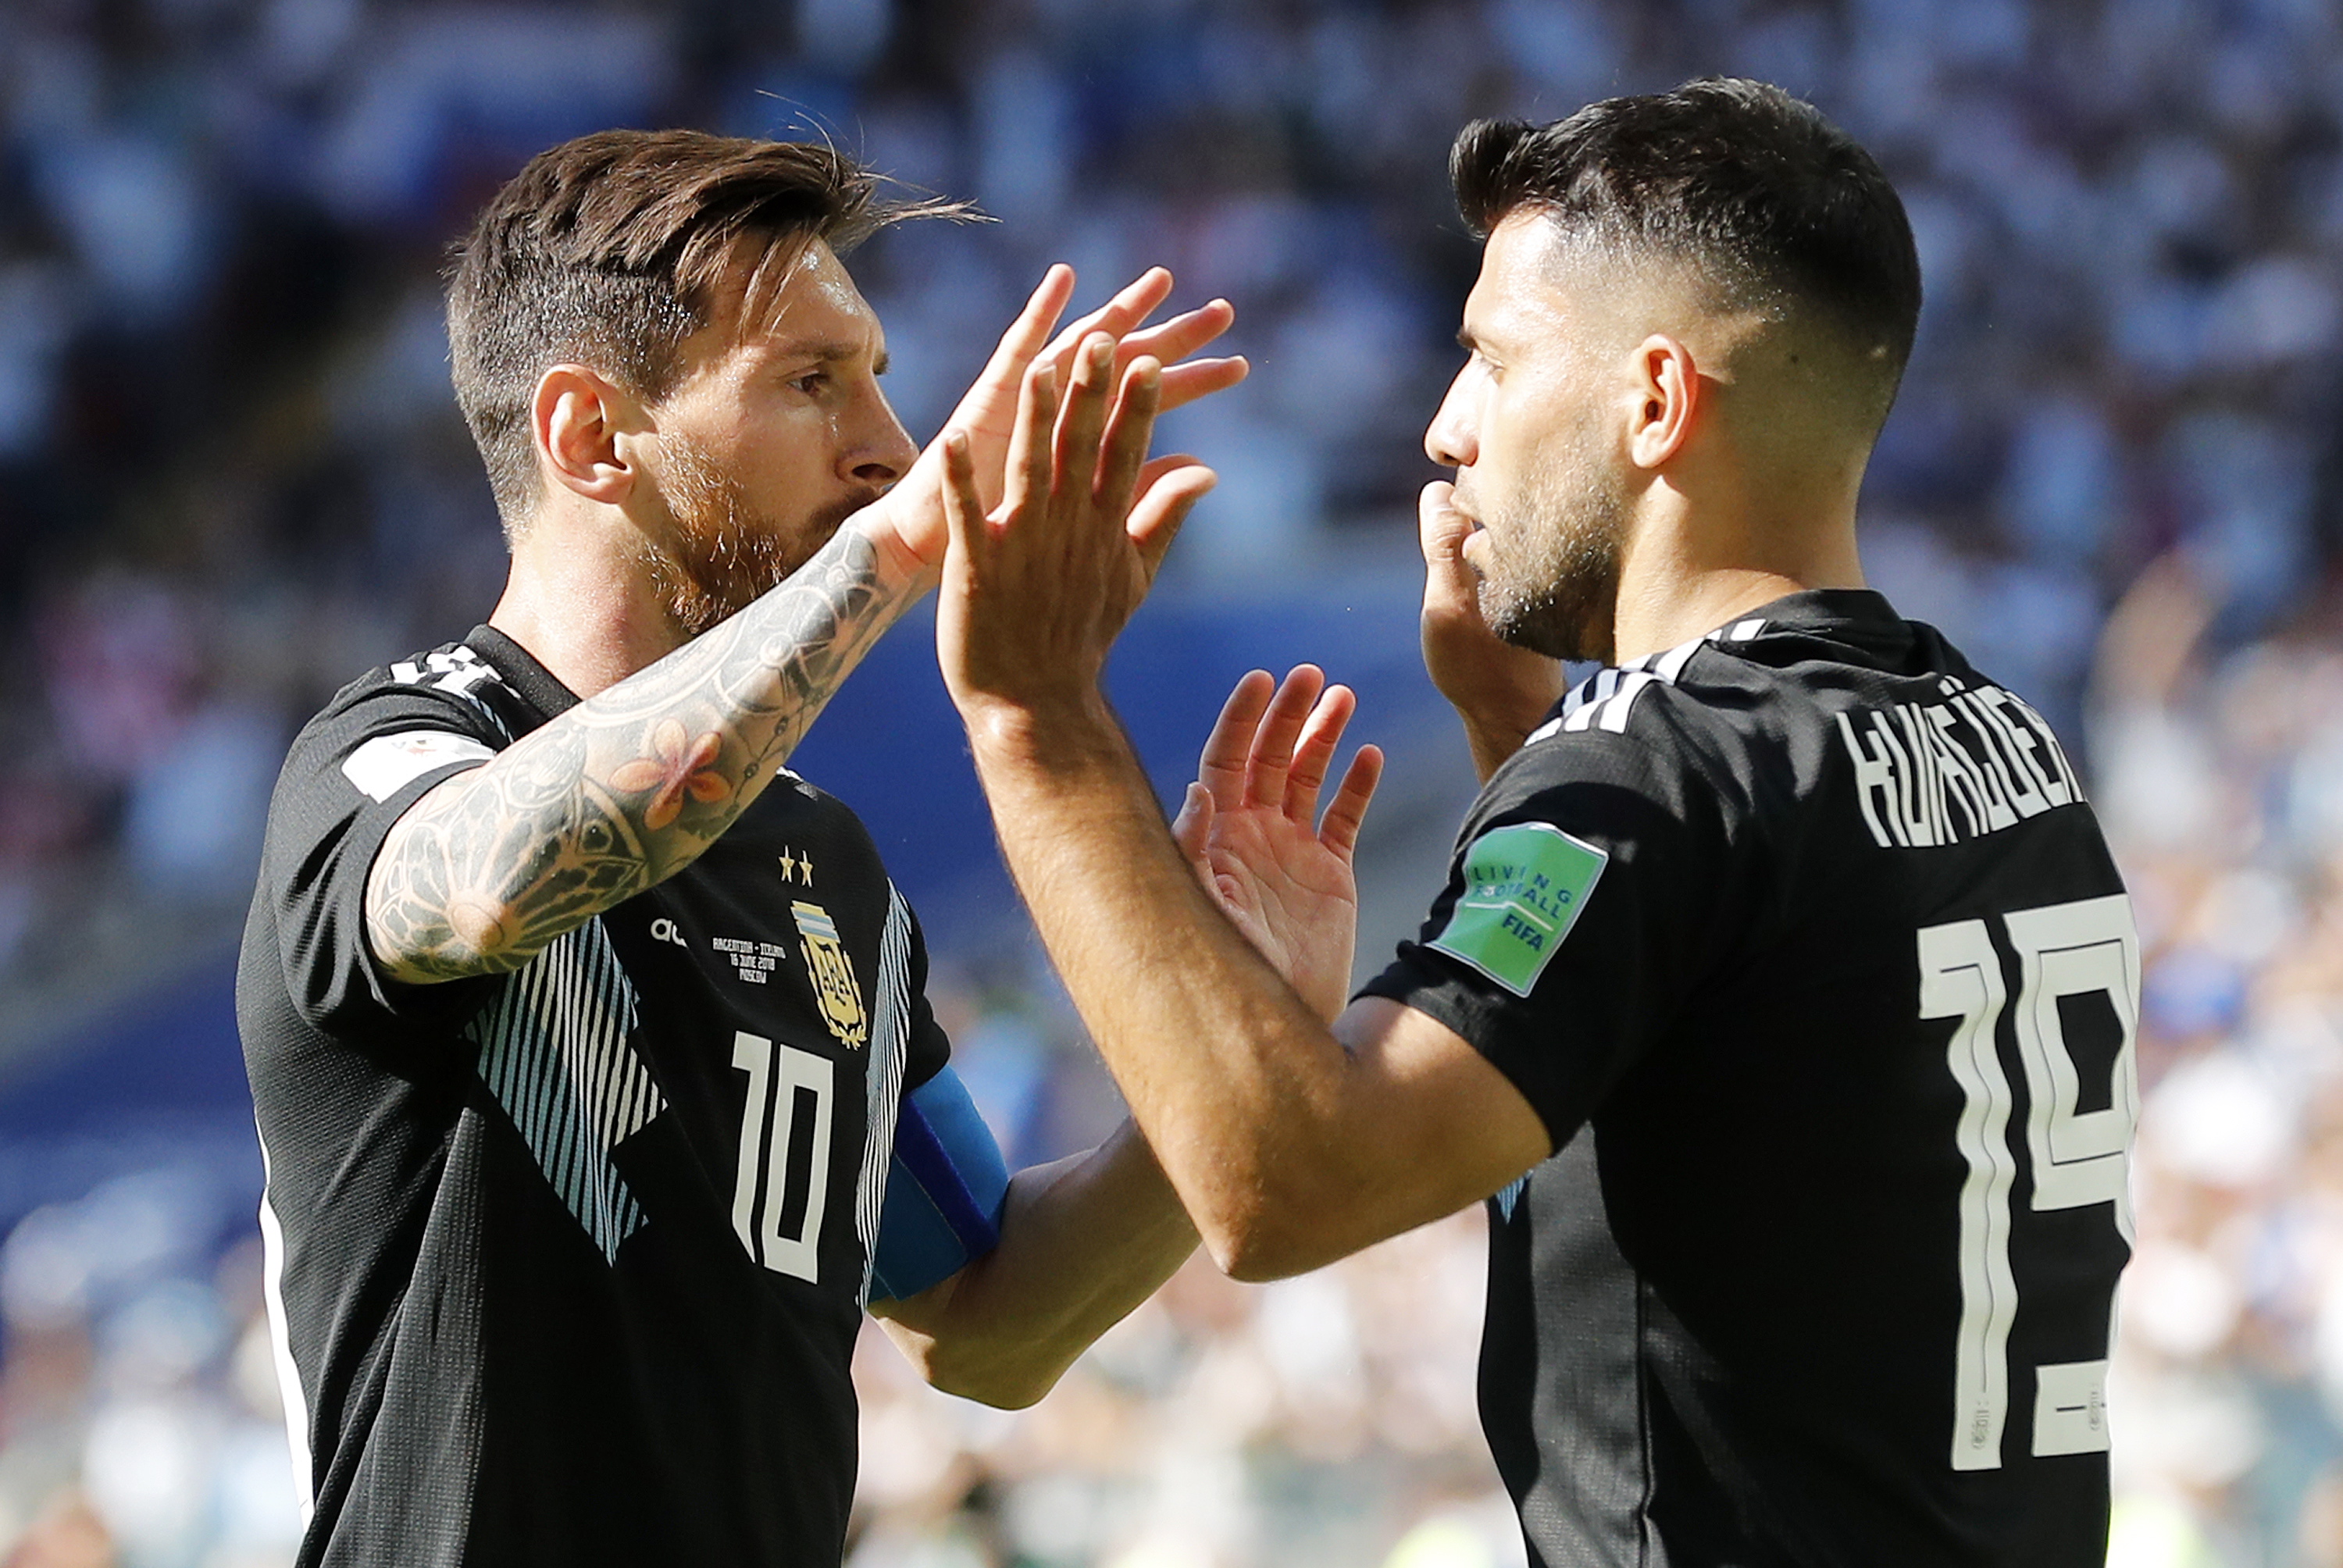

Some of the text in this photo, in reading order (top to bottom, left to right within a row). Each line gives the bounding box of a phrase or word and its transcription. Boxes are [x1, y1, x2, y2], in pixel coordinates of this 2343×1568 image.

[1473, 866, 1573, 904] LIVING
[1501, 914, 1544, 952] FIFA
[731, 1030, 834, 1285] 10
[1917, 894, 2140, 1470] 19
